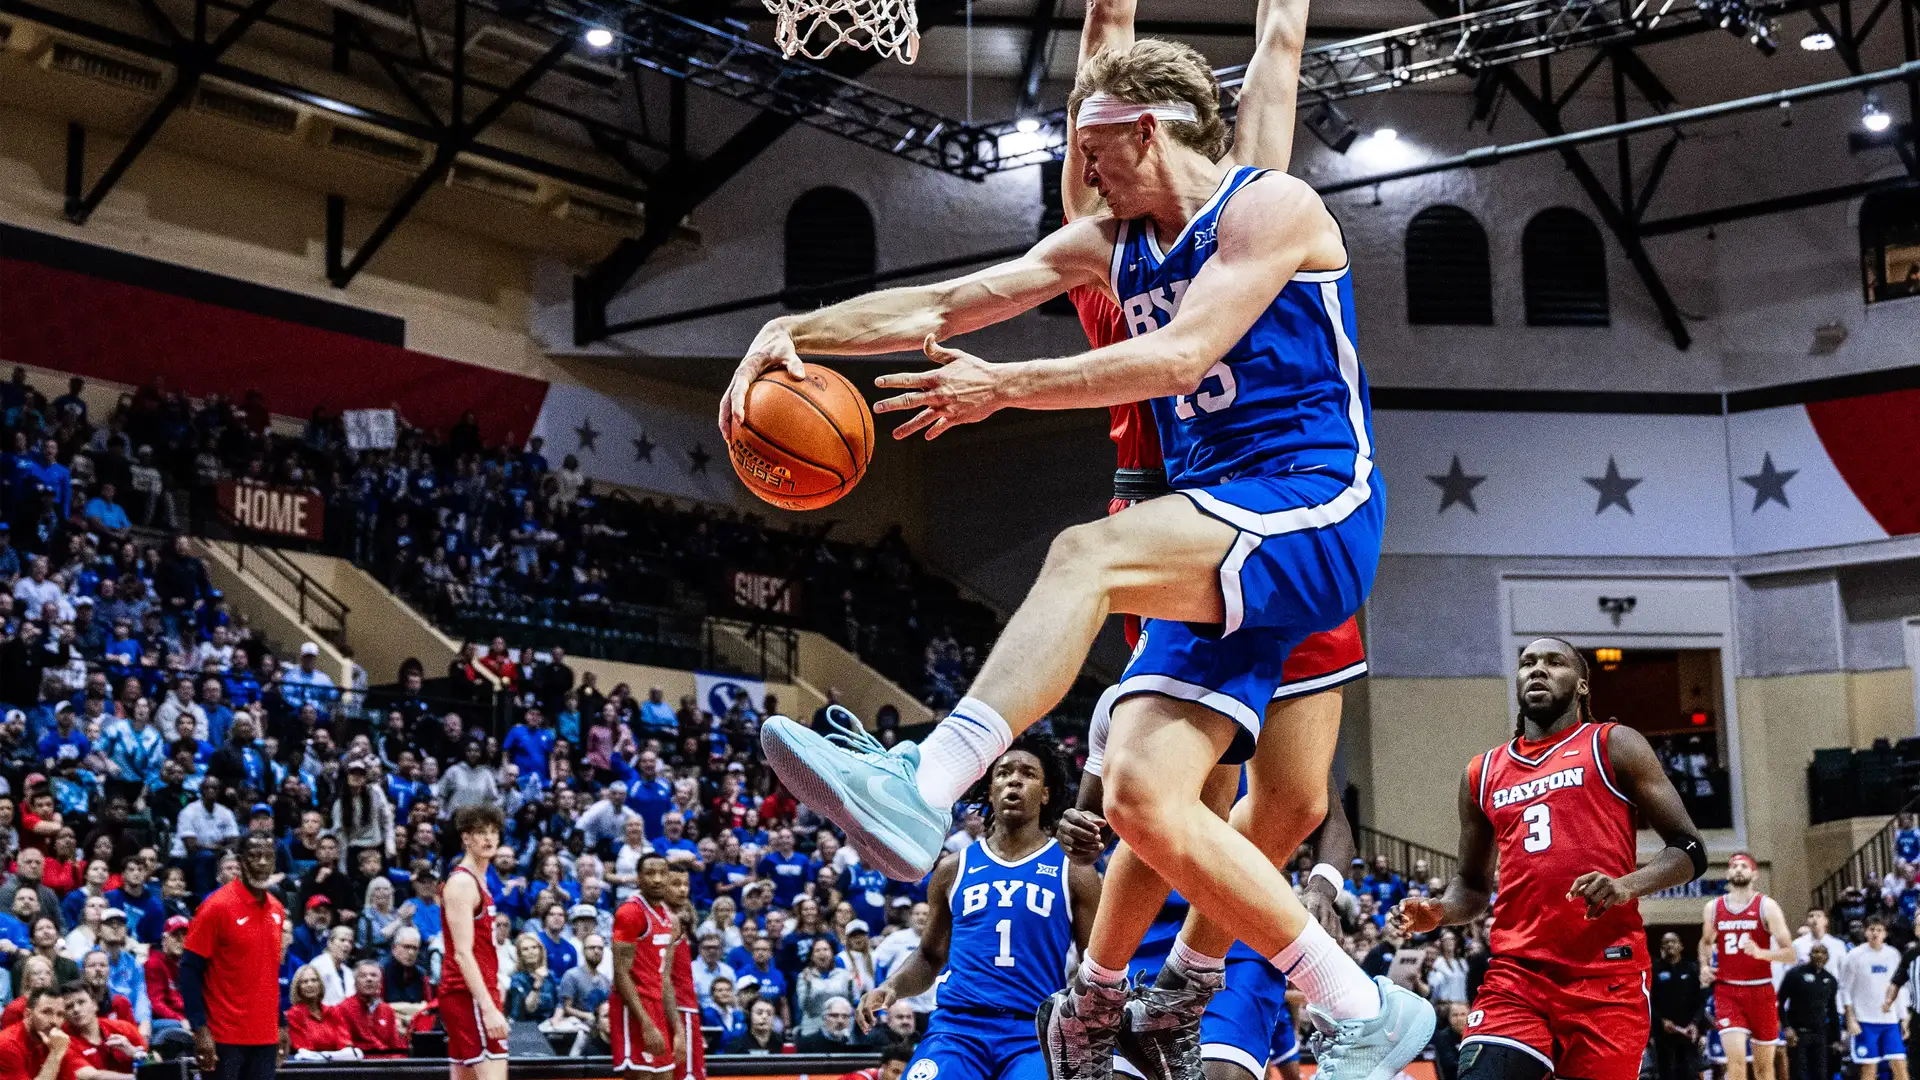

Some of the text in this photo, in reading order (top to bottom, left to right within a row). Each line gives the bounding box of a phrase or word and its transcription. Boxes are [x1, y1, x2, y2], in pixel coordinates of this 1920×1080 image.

[1123, 278, 1192, 338] BY
[234, 485, 308, 536] HOME
[1492, 767, 1584, 809] DAYTON
[1522, 803, 1552, 854] 3
[962, 880, 1056, 918] BYU
[994, 919, 1015, 967] 1
